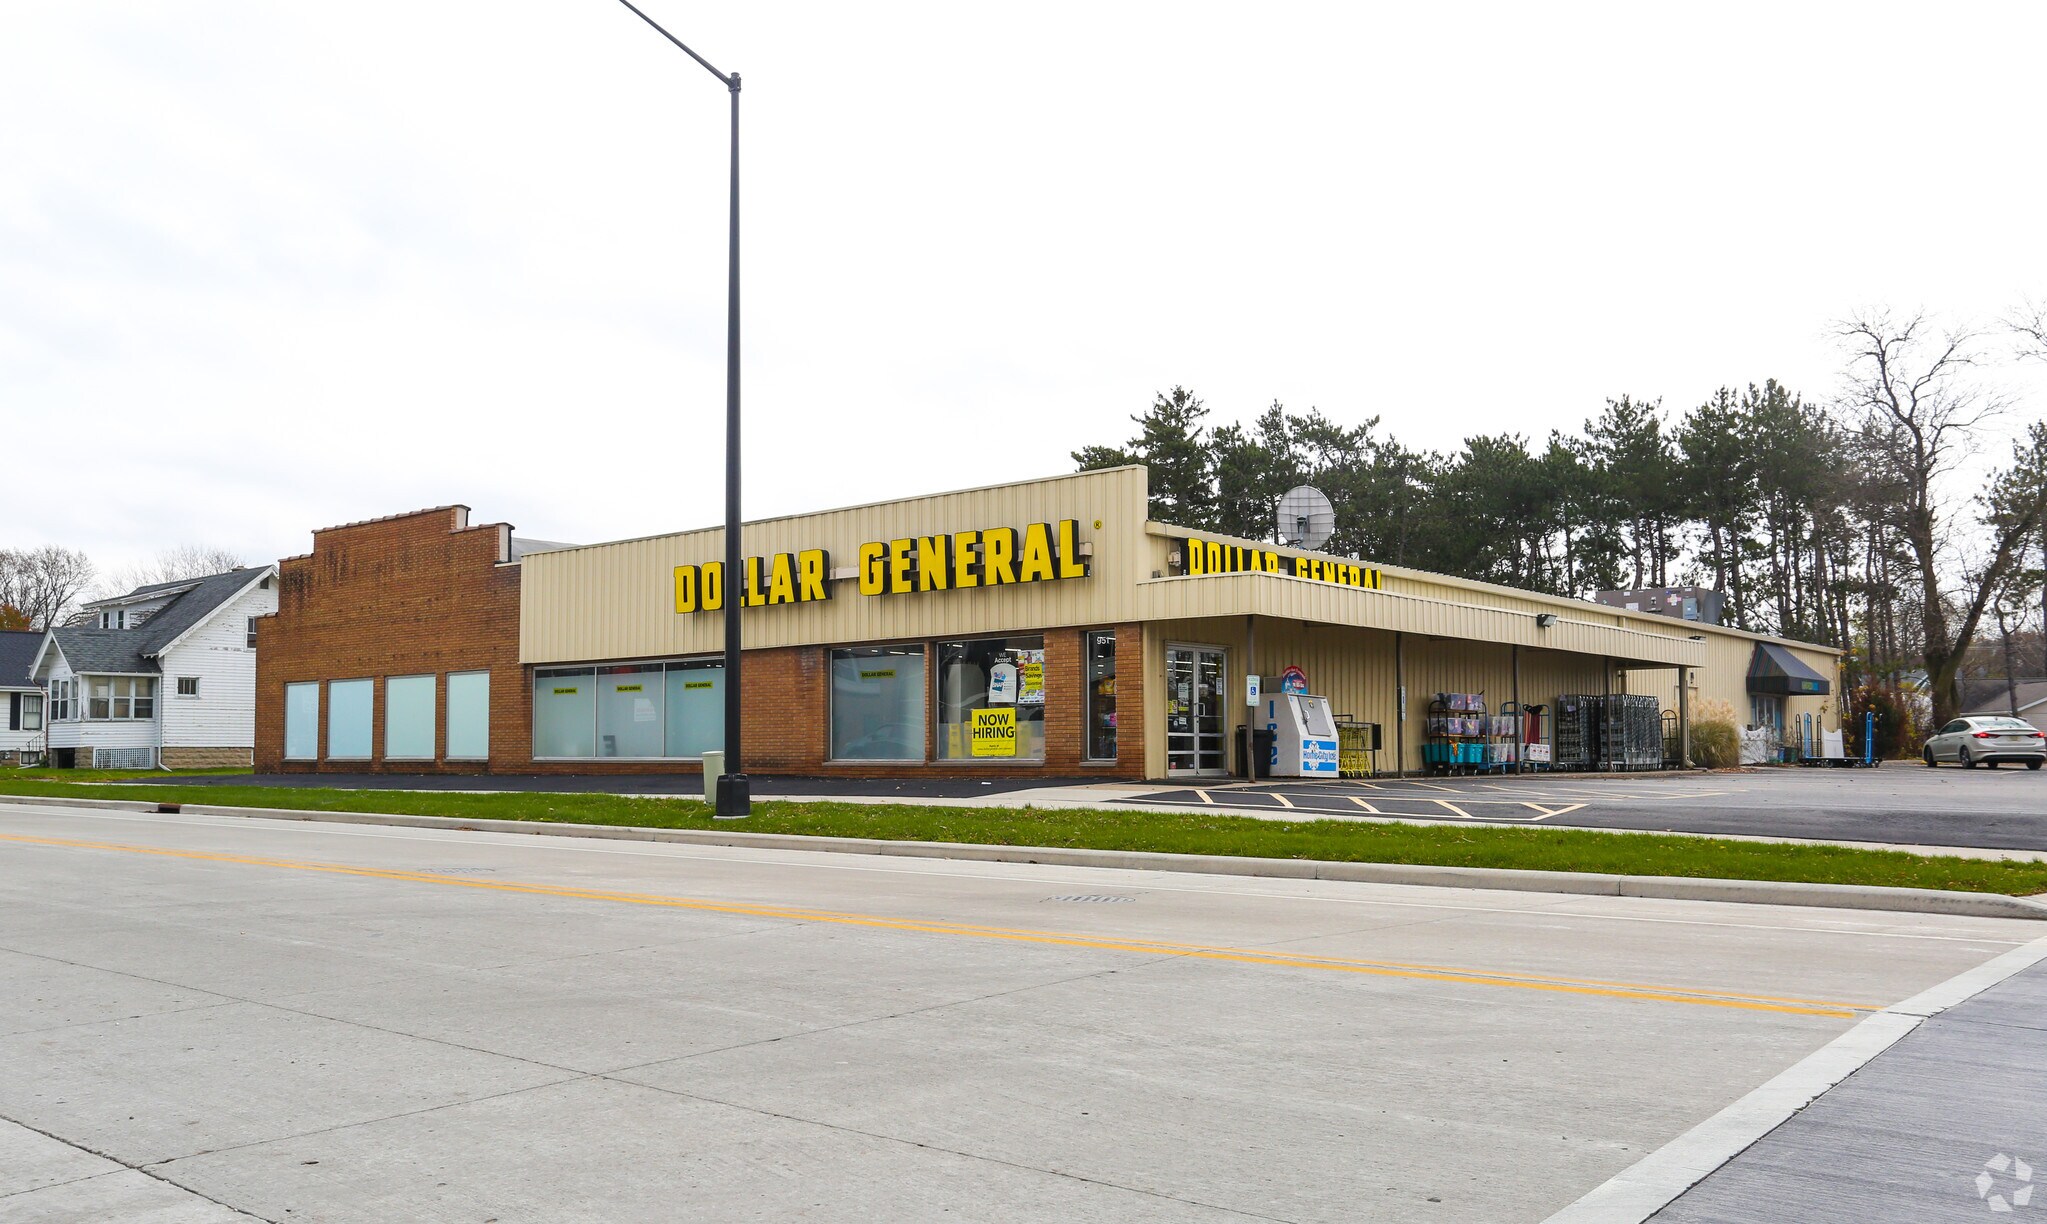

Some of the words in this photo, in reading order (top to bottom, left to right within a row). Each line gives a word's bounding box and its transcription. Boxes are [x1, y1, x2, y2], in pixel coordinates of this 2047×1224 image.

[674, 549, 830, 614] DOLAR
[859, 519, 1087, 596] GENERAL
[978, 714, 1009, 726] NOW
[973, 726, 1015, 739] HIRING
